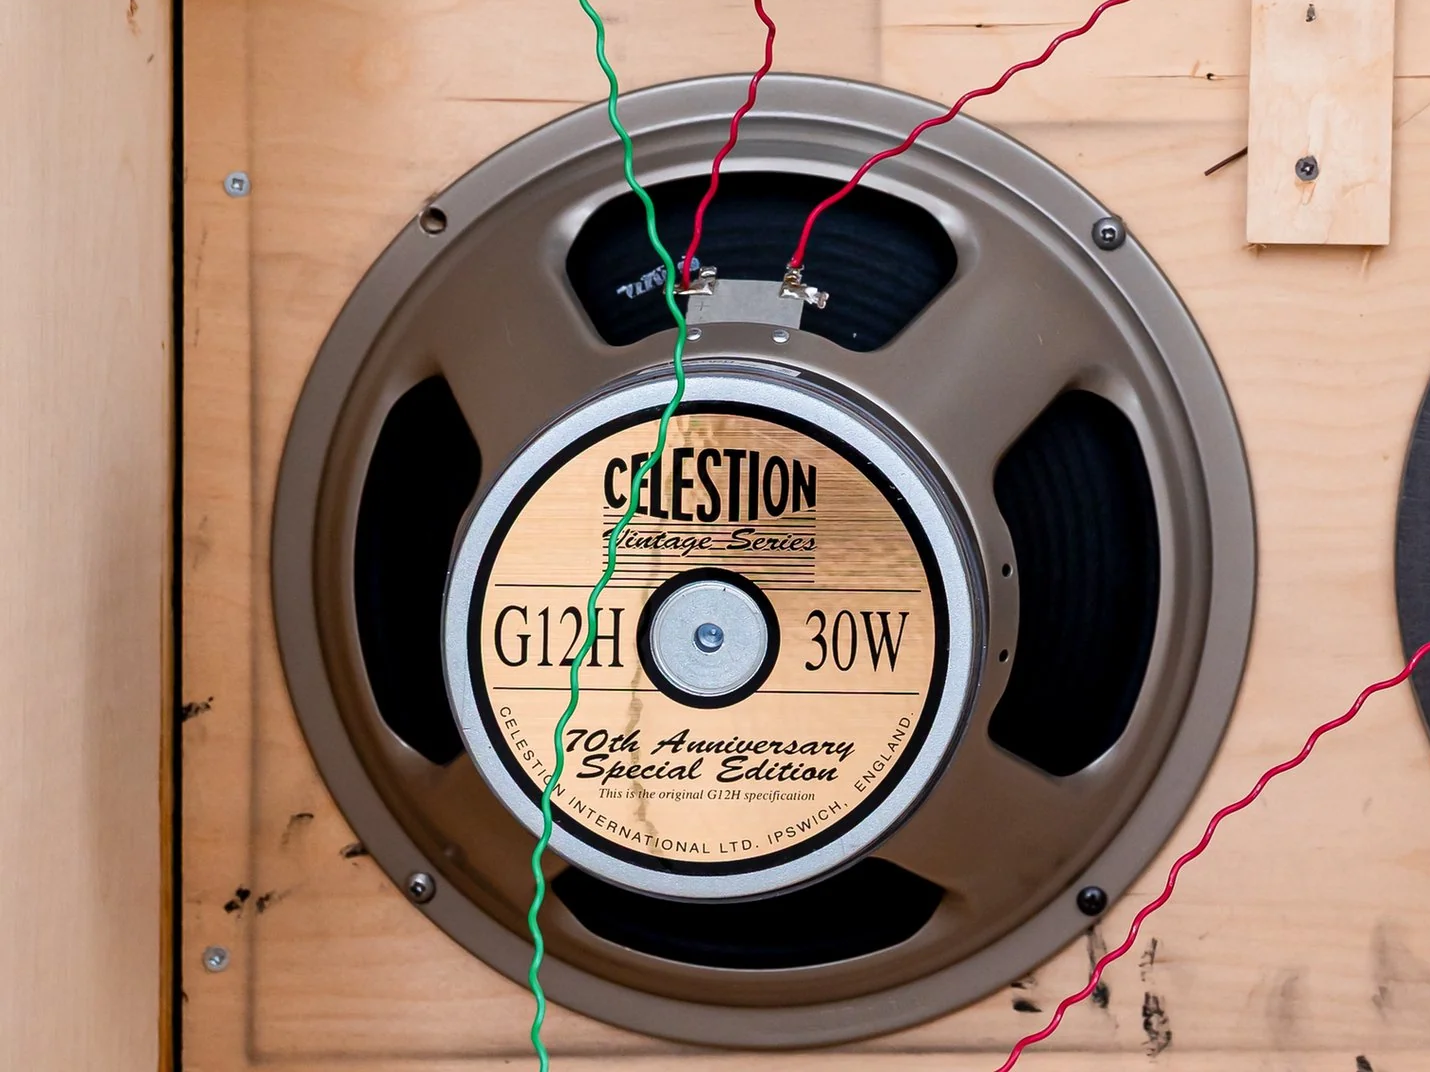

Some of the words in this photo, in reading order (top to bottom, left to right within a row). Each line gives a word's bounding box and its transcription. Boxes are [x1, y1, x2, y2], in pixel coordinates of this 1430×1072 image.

[604, 447, 817, 523] CELESTION
[726, 528, 817, 551] Series
[494, 605, 625, 668] G12H
[804, 609, 910, 673] 30W
[566, 729, 641, 753] 70th
[650, 728, 855, 762] Anniversary
[568, 796, 711, 854] INTERNATIONAL
[719, 839, 760, 854] LTD.
[767, 800, 848, 845] IPSWICH,
[854, 712, 914, 793] ENGLAND.
[576, 753, 704, 785] Special
[716, 755, 839, 783] Edition
[599, 788, 623, 799] This
[625, 789, 635, 799] is
[638, 789, 656, 799] the
[658, 789, 704, 803] original
[707, 789, 741, 801] G12H
[743, 789, 815, 803] specification
